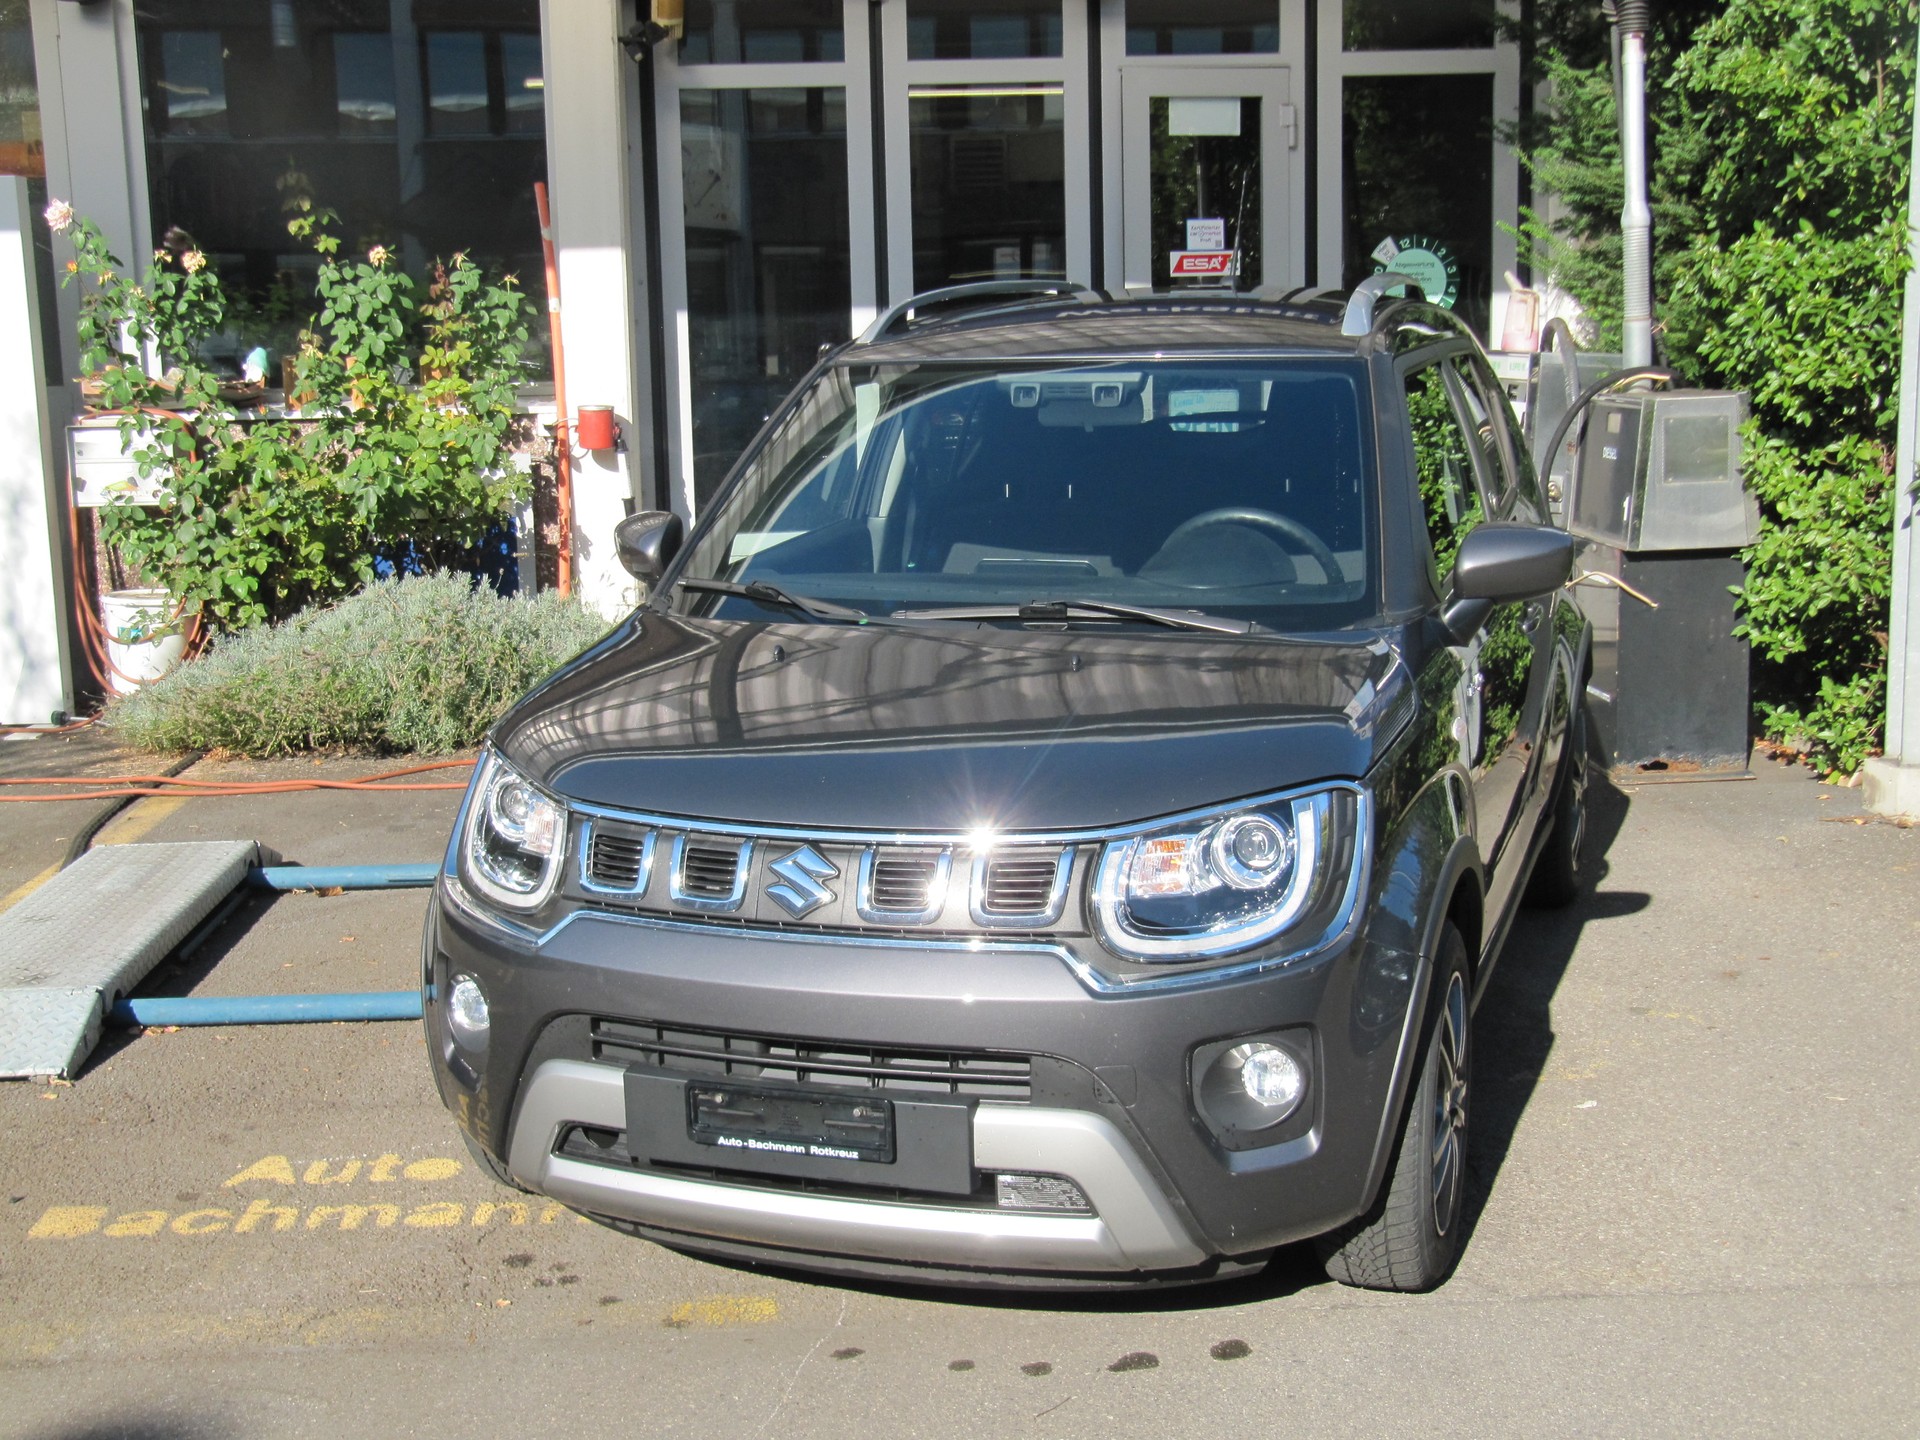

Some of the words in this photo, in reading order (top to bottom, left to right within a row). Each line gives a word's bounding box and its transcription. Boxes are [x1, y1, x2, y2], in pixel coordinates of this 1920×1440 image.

[1399, 238, 1411, 249] 12
[1422, 238, 1428, 248] 1
[1437, 247, 1447, 258] 2
[1183, 258, 1221, 271] ESA
[1447, 264, 1457, 274] 3
[1447, 285, 1456, 294] 4
[810, 1145, 860, 1160] Rotkreuz
[221, 1154, 464, 1188] Auto
